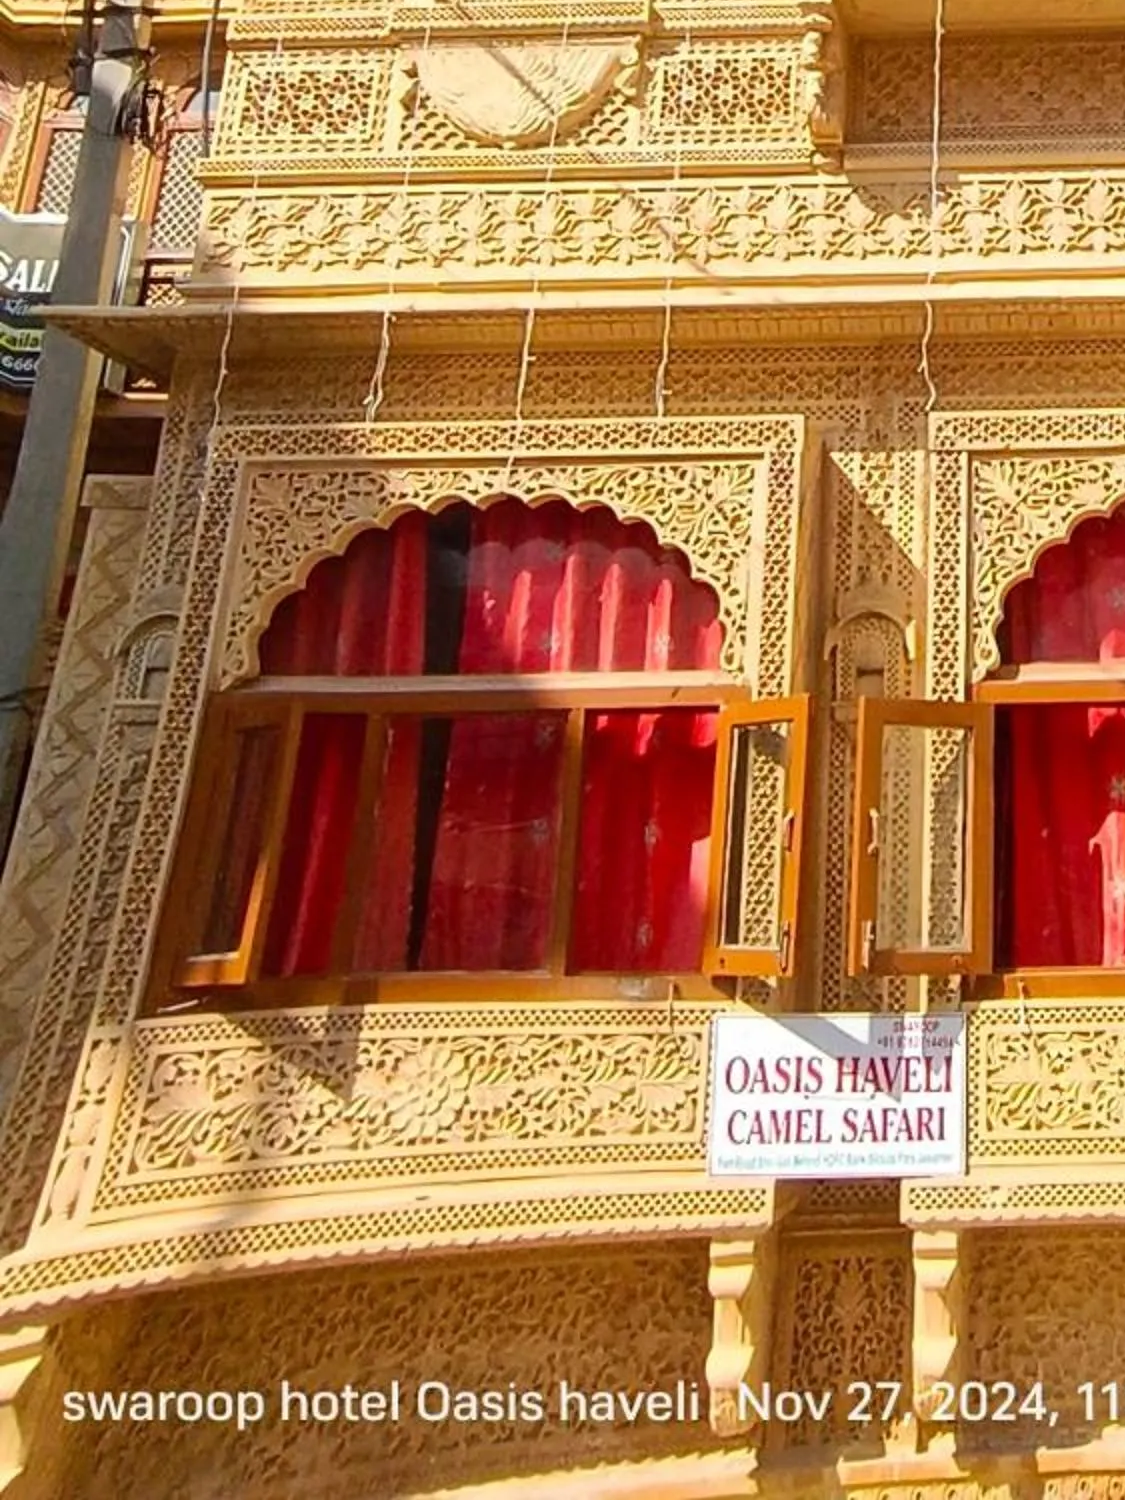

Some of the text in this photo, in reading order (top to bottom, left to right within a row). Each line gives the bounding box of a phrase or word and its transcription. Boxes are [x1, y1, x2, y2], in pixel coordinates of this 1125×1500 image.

[724, 1054, 952, 1094] OASIS HAVELI
[726, 1106, 946, 1146] CAMEL SAFARI
